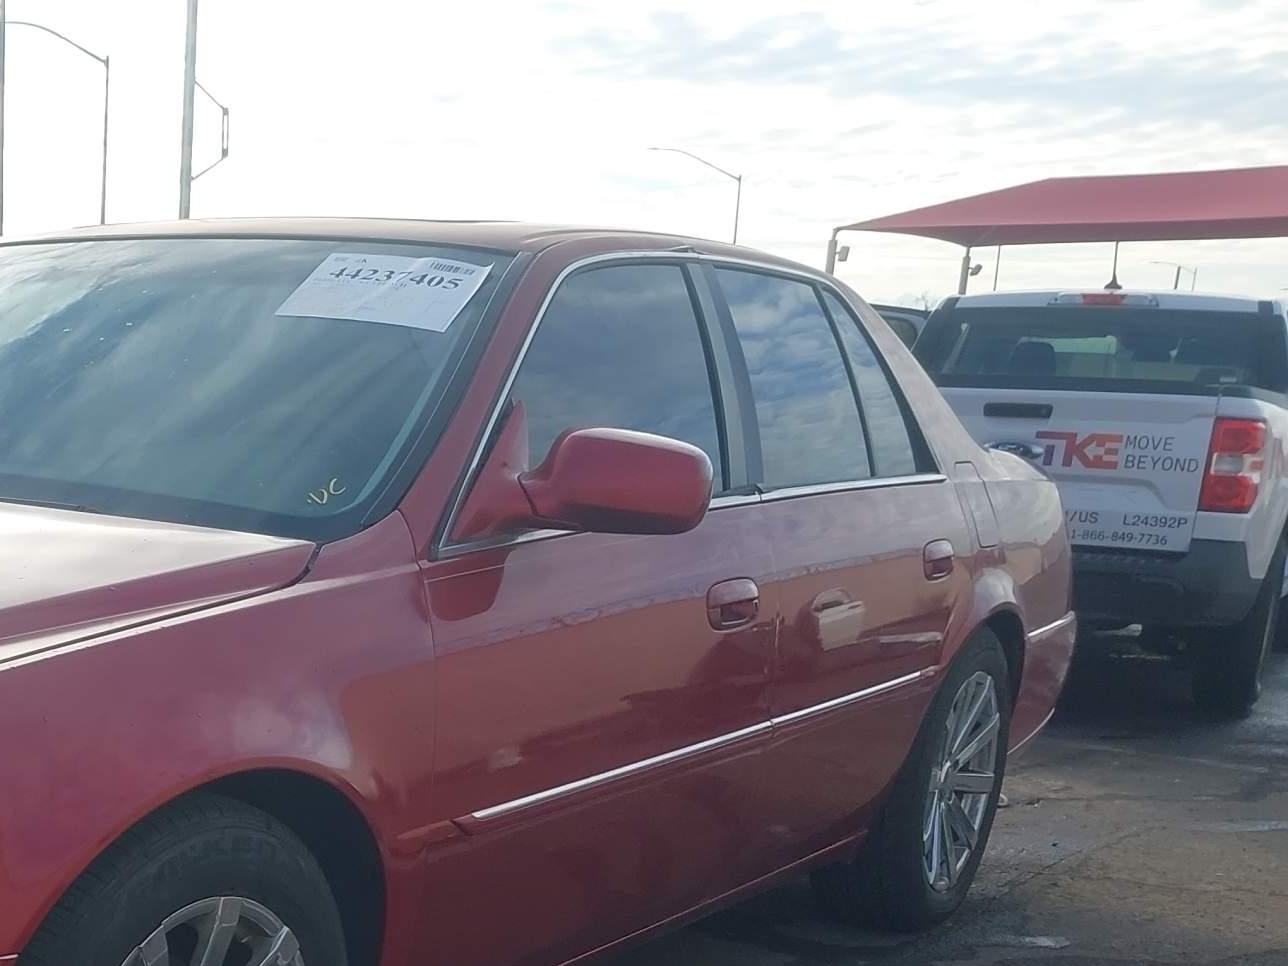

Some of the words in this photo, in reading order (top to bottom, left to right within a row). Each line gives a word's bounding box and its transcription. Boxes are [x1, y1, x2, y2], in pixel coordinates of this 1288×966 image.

[329, 266, 464, 290] 44237405
[1036, 431, 1124, 470] TKE
[1124, 434, 1176, 452] MOVE
[1124, 454, 1199, 473] BEYOND
[1123, 513, 1188, 529] L24392P
